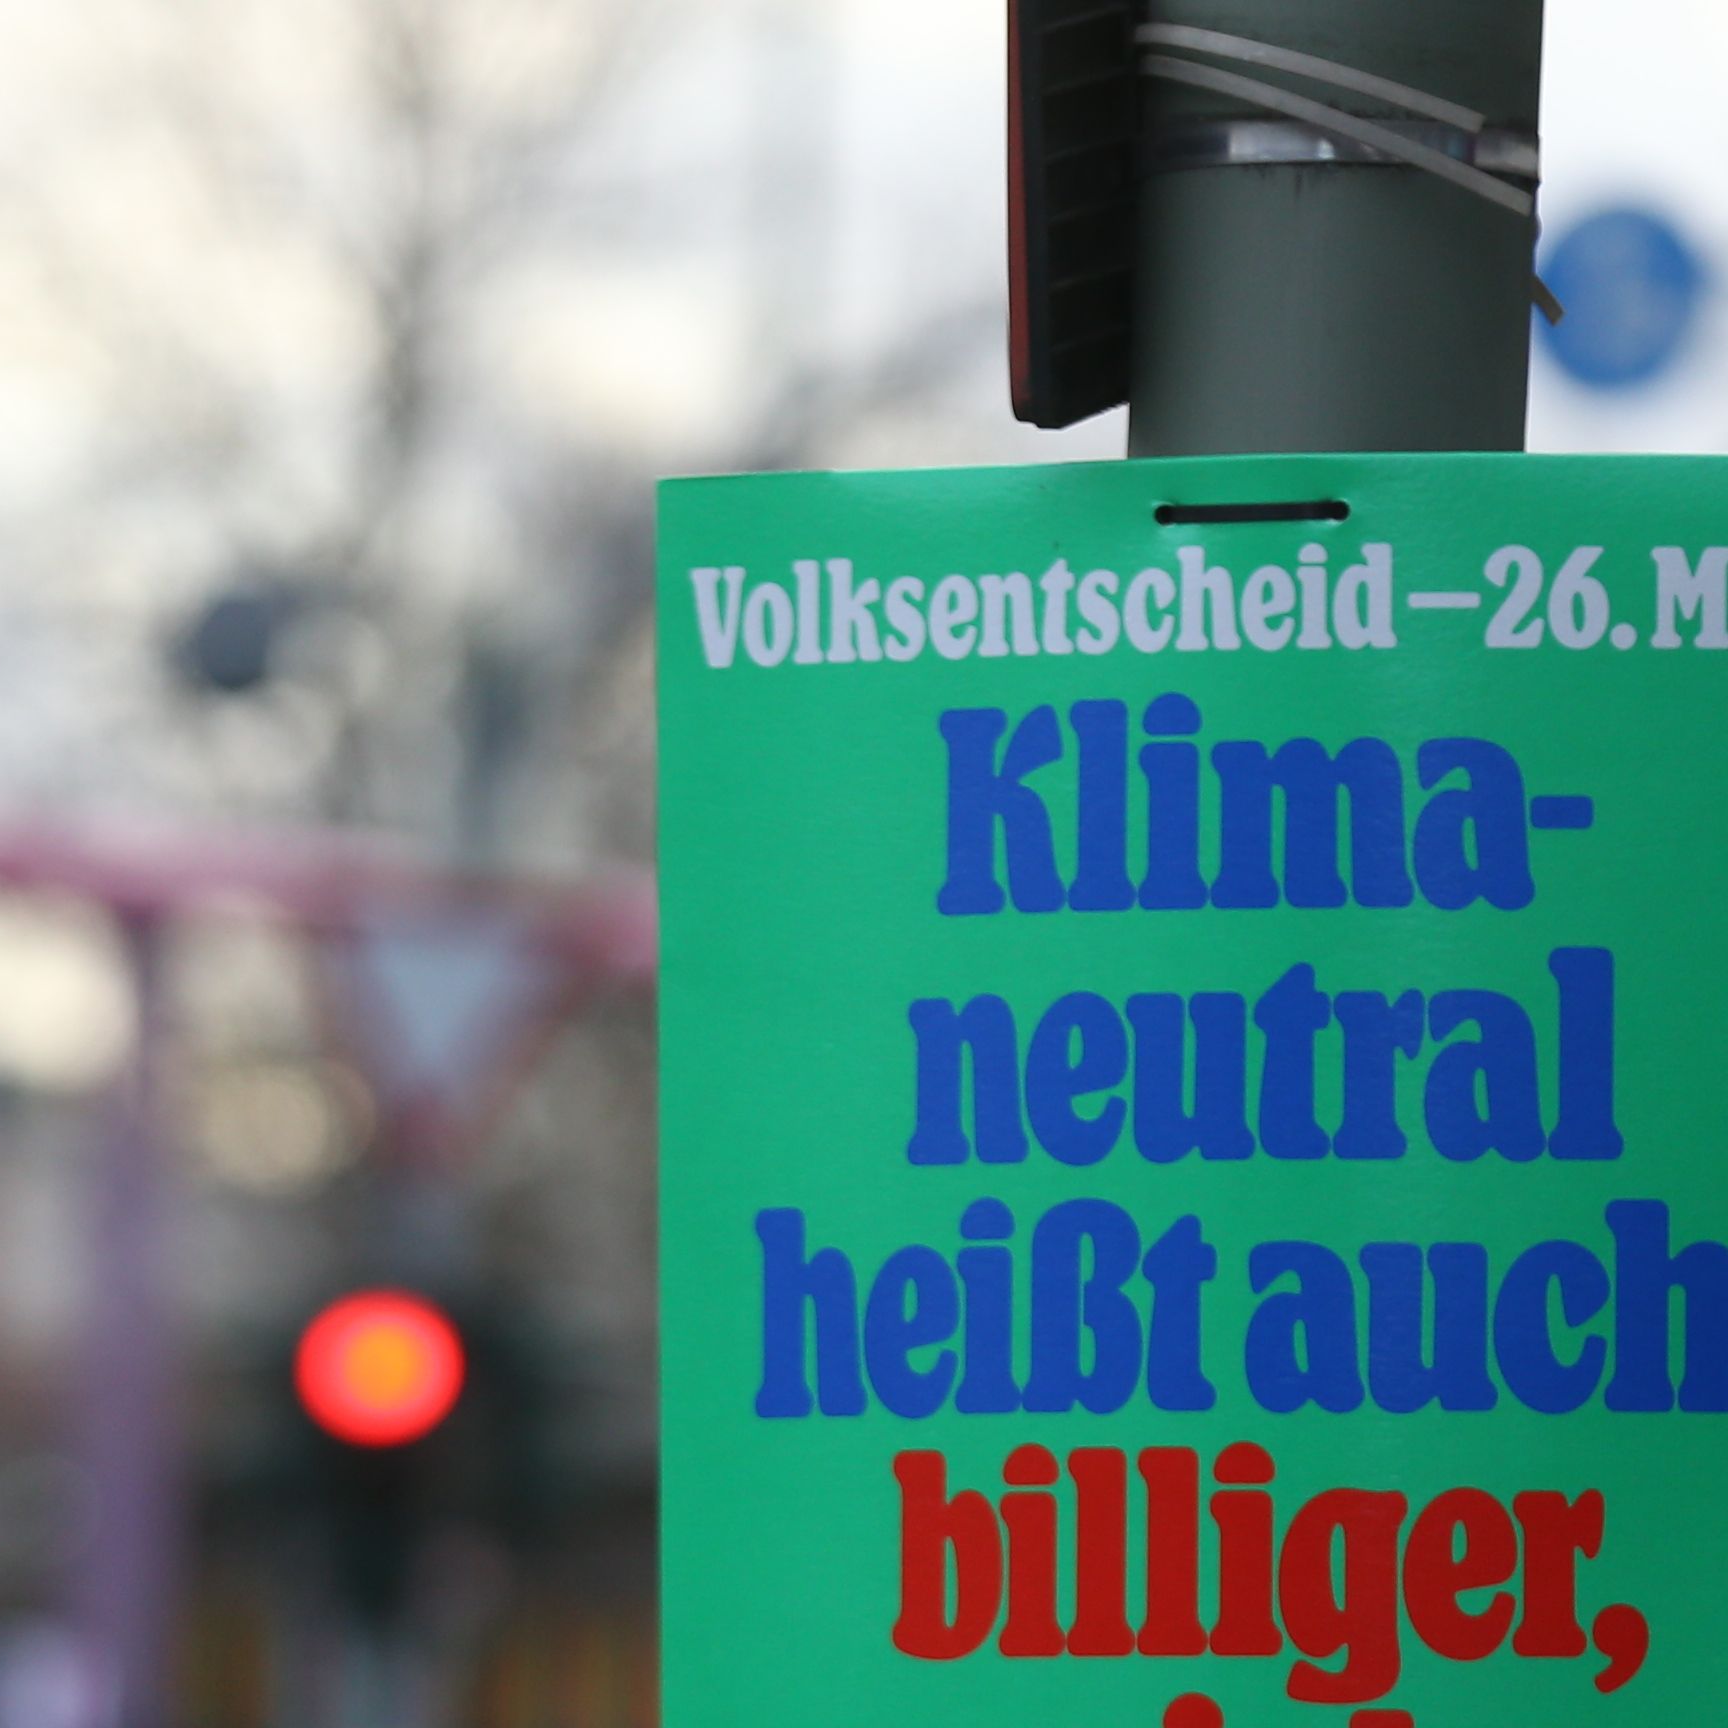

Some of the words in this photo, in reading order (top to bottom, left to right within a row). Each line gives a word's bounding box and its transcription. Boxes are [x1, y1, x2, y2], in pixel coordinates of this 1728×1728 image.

[934, 690, 1596, 918] Klima-
[904, 944, 1626, 1169] neutral
[752, 1195, 1219, 1422] heißt
[891, 1441, 1649, 1705] billiger,
